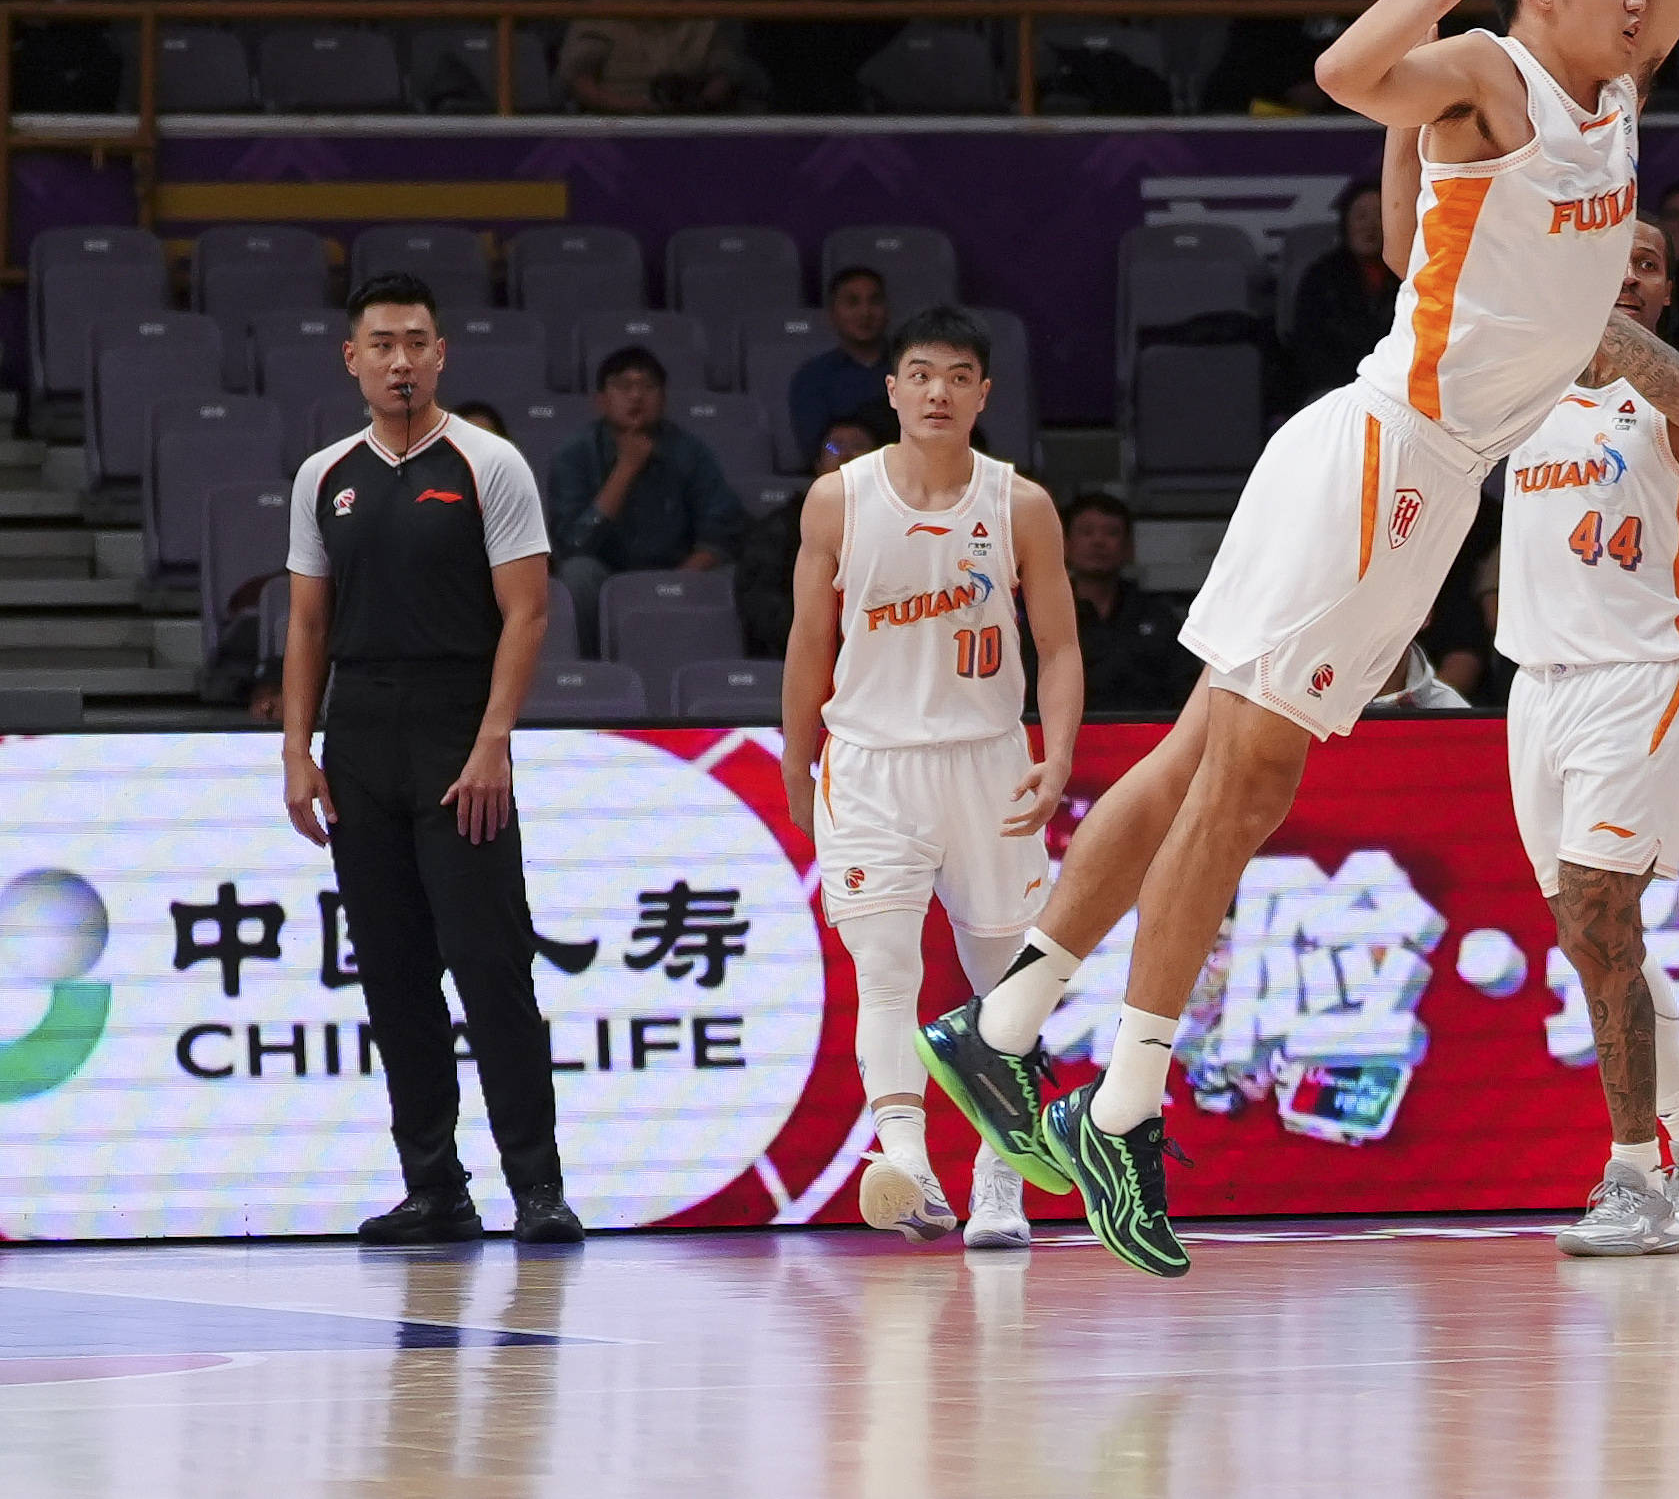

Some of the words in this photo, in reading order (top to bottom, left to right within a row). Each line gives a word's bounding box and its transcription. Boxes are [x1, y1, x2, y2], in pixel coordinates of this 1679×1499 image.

[1547, 177, 1635, 234] FUJI
[1513, 456, 1608, 496] FUJIAN
[1568, 509, 1643, 572] 44
[863, 582, 976, 631] FUJIAN
[953, 624, 1002, 679] 10
[175, 1017, 483, 1078] CHI
